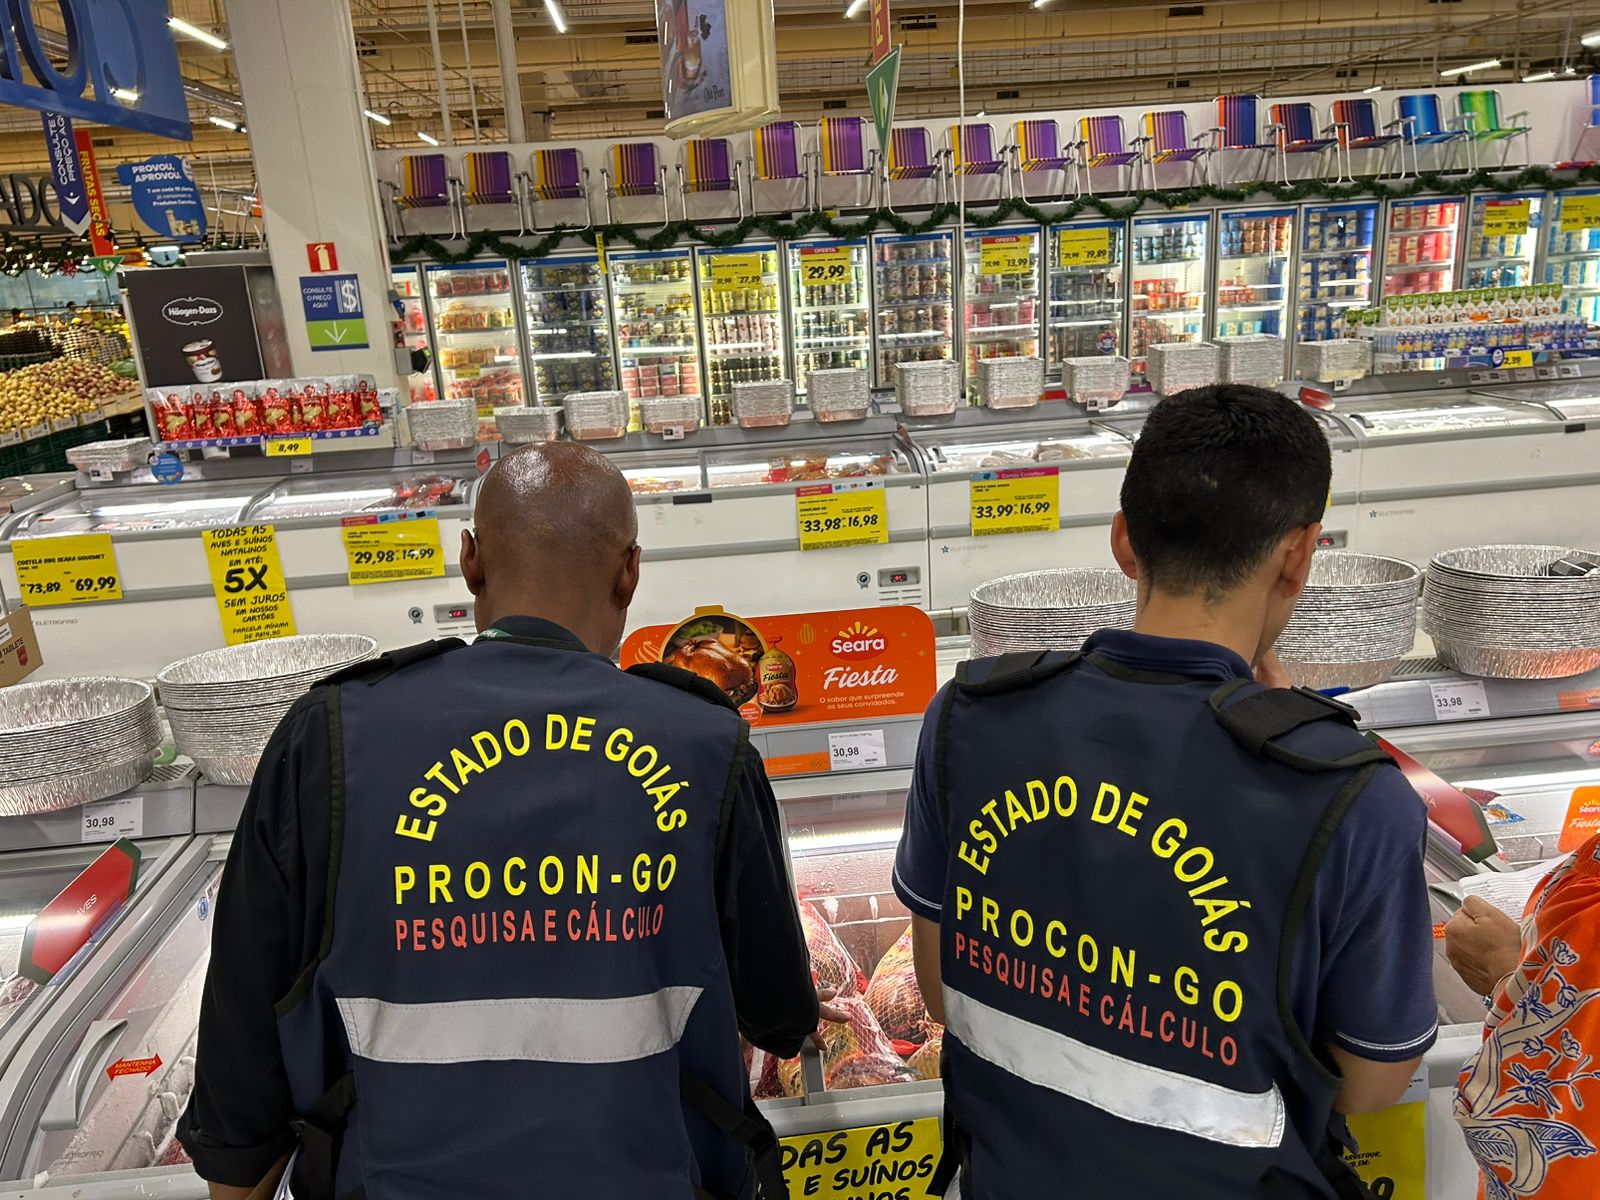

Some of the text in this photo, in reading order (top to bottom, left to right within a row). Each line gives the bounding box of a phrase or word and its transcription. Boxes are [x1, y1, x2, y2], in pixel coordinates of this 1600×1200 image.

[80, 151, 106, 237] FRUTAS SECAS
[808, 265, 845, 280] 29,99
[303, 286, 333, 294] CONSULTE
[278, 442, 300, 454] 8,49
[975, 502, 1051, 519] 33,99 16,99
[804, 514, 878, 532] 33,98 16,98
[210, 525, 266, 539] TODAS AS
[210, 540, 231, 549] AVES
[244, 535, 273, 545] SUÍNOS
[221, 544, 267, 557] NATALINOS
[355, 550, 395, 565] 29,98
[229, 559, 241, 567] EM
[27, 576, 116, 594] 73,89 69,99
[224, 564, 268, 593] 5X
[224, 592, 285, 608] SEM JUROS
[236, 604, 278, 616] EM NOSSOS
[242, 612, 275, 623] CARTÕES
[233, 625, 261, 634] PARCELA
[832, 637, 885, 654] Seara
[763, 671, 788, 682] Fiesta
[823, 664, 899, 691] Fiesta
[828, 695, 848, 703] sabor
[849, 695, 862, 704] que
[864, 691, 905, 702] surpreende
[1437, 697, 1462, 707] 33,98
[833, 746, 859, 757] 30,98
[394, 713, 690, 842] ESTADO DE GOIÁS
[86, 816, 115, 828] 30,98
[958, 775, 1252, 953] ESTADO DE GOIÁS
[395, 900, 664, 951] PESQUISA E CÁLCULO
[955, 931, 1238, 1066] PESQUISA E CÁLCULO
[113, 1066, 151, 1075] FECHADO
[115, 1060, 157, 1068] MANTENHA
[779, 1121, 913, 1171] DAS AS
[804, 1174, 821, 1196] E
[833, 1154, 934, 1190] SUÍNOS
